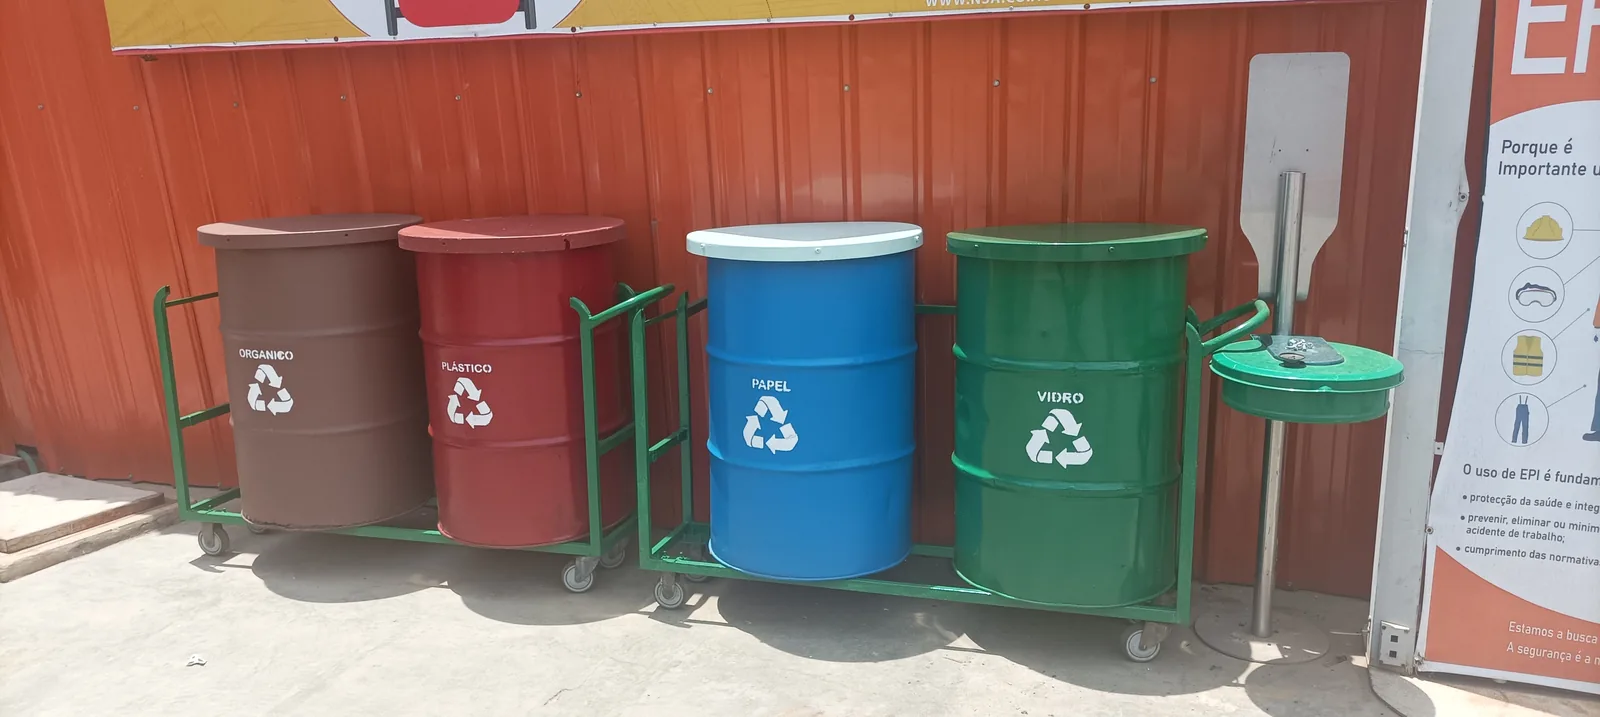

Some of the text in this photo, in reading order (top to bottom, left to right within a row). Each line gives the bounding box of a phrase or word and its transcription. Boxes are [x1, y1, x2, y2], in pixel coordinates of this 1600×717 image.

[1501, 137, 1573, 158] Porque é
[1498, 160, 1587, 179] Importante
[239, 348, 294, 360] ORGANICO
[441, 361, 492, 373] PLÁSTICO
[752, 378, 791, 392] PAPEL
[1037, 390, 1084, 404] VIDRO
[1463, 463, 1472, 475] O
[1475, 467, 1498, 478] uso
[1501, 467, 1516, 480] de
[1519, 468, 1540, 481] EPI
[1543, 468, 1551, 482] é
[1469, 494, 1600, 515] protecção da saúde e integ
[1467, 514, 1600, 534] prevenir, eliminar ou minim
[1466, 525, 1566, 544] acidente de trabalho;
[1464, 545, 1600, 567] cumprimento das normativa
[1508, 621, 1598, 644] Estamos a busca
[1506, 641, 1514, 653] A
[1517, 645, 1572, 663] segurança
[1574, 650, 1582, 663] é
[1584, 655, 1591, 664] a
